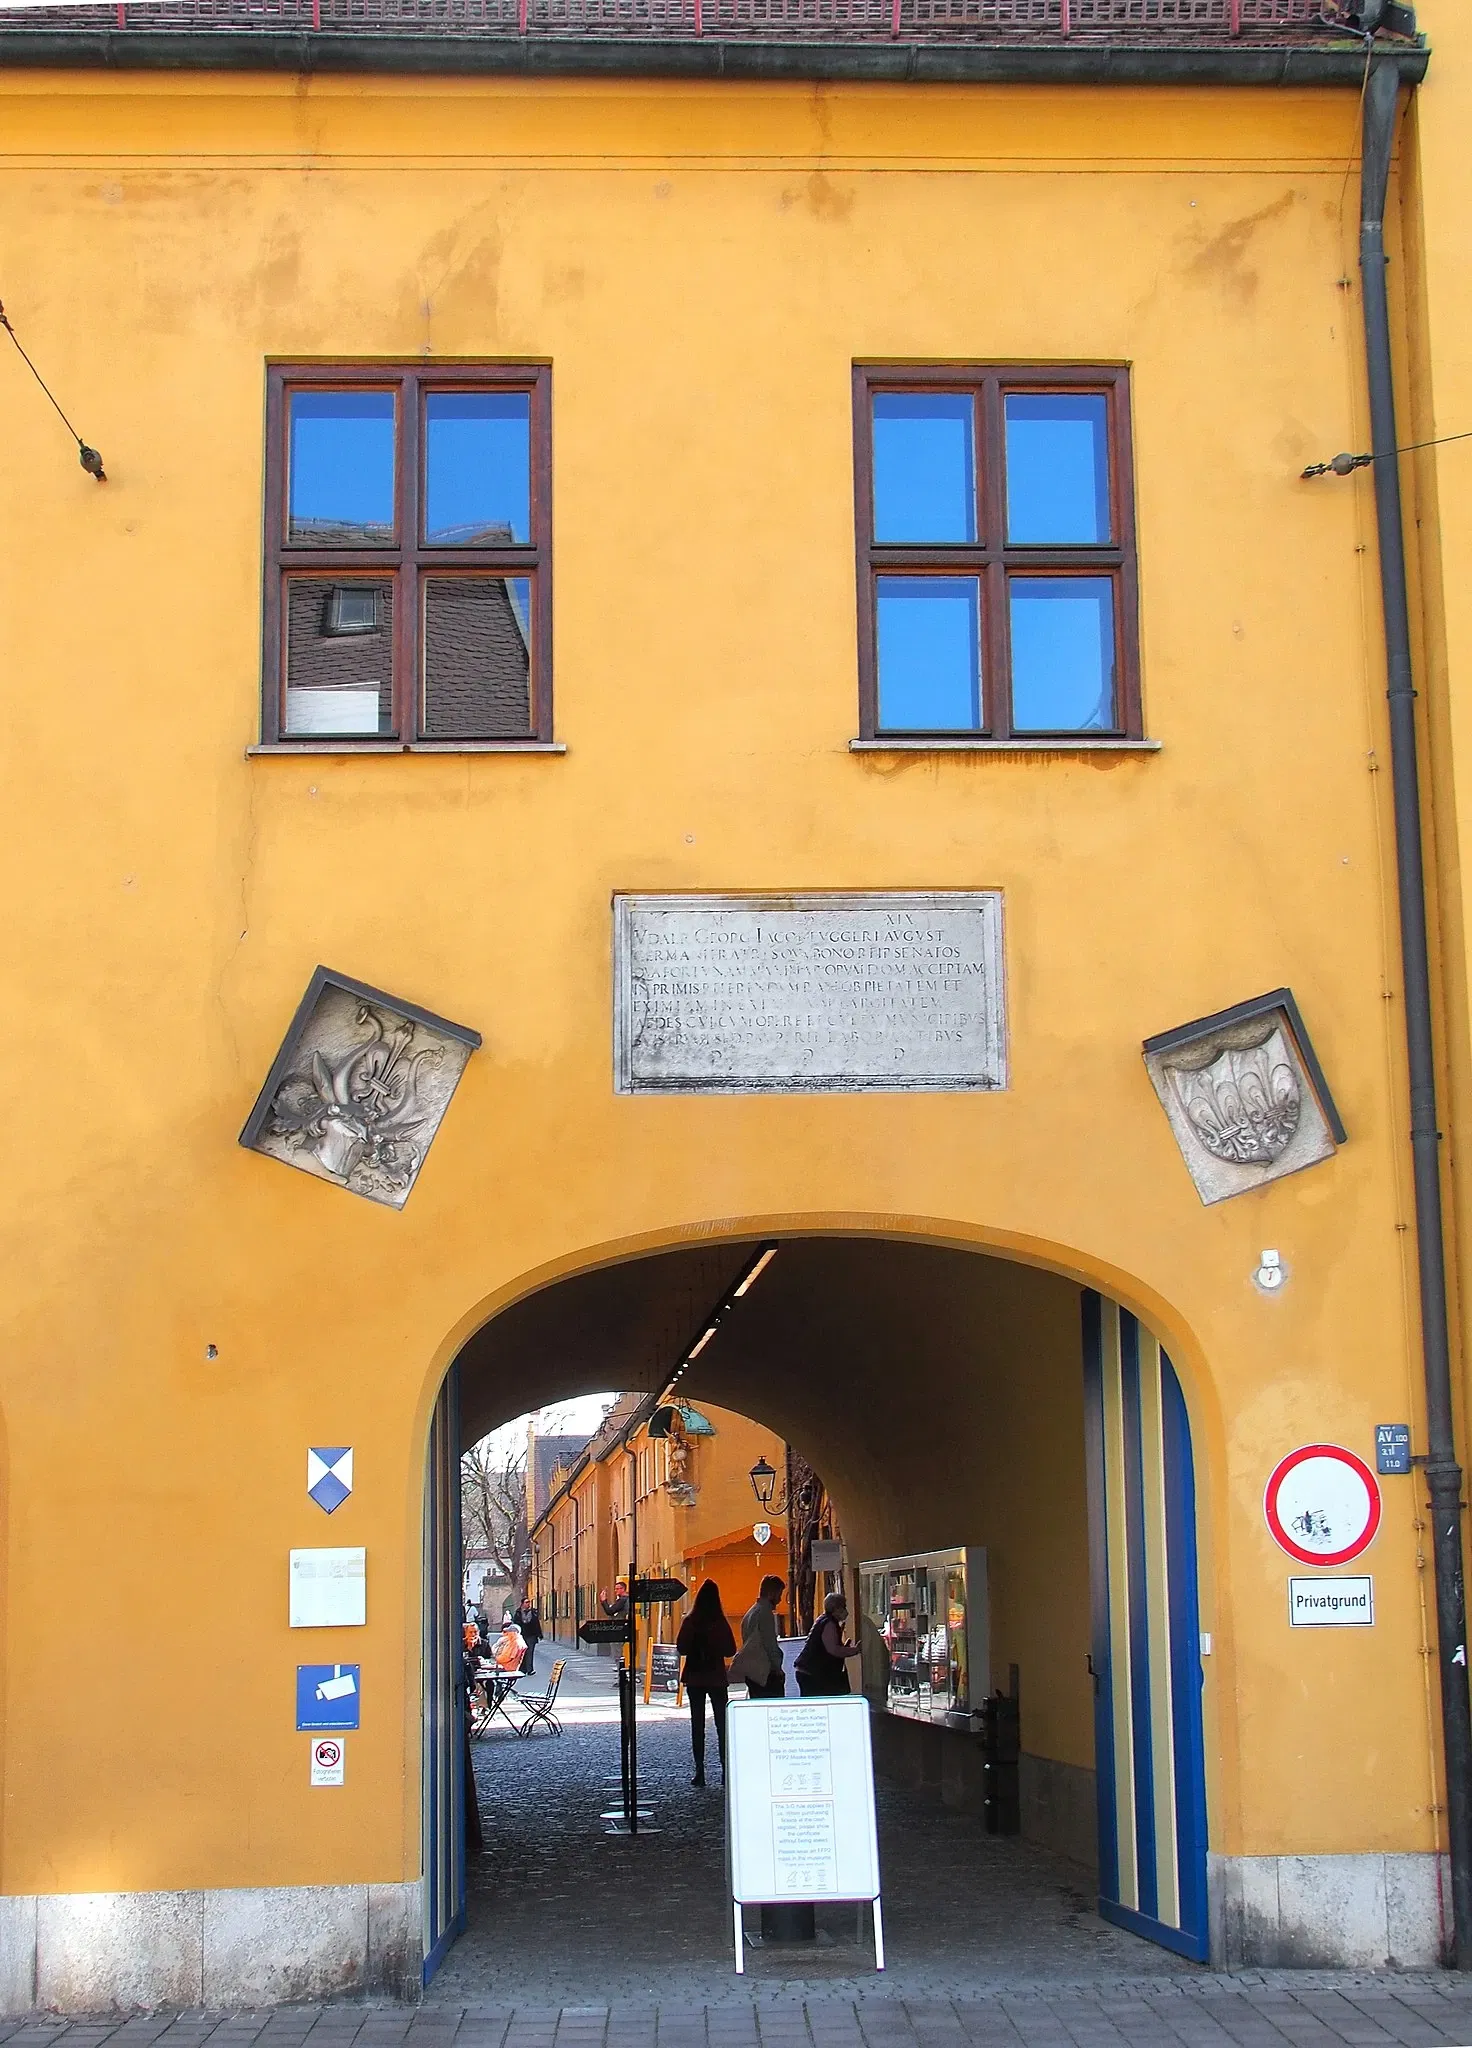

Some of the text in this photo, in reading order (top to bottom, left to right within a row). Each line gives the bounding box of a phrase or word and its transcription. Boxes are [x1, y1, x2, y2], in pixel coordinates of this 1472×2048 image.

[886, 914, 915, 925] XIX
[883, 930, 944, 943] AVGVST
[652, 983, 700, 995] PRIMIS
[943, 980, 961, 991] ET
[893, 1047, 905, 1060] D
[1378, 1430, 1408, 1443] AV 100
[1295, 1593, 1367, 1611] Privatgrund
